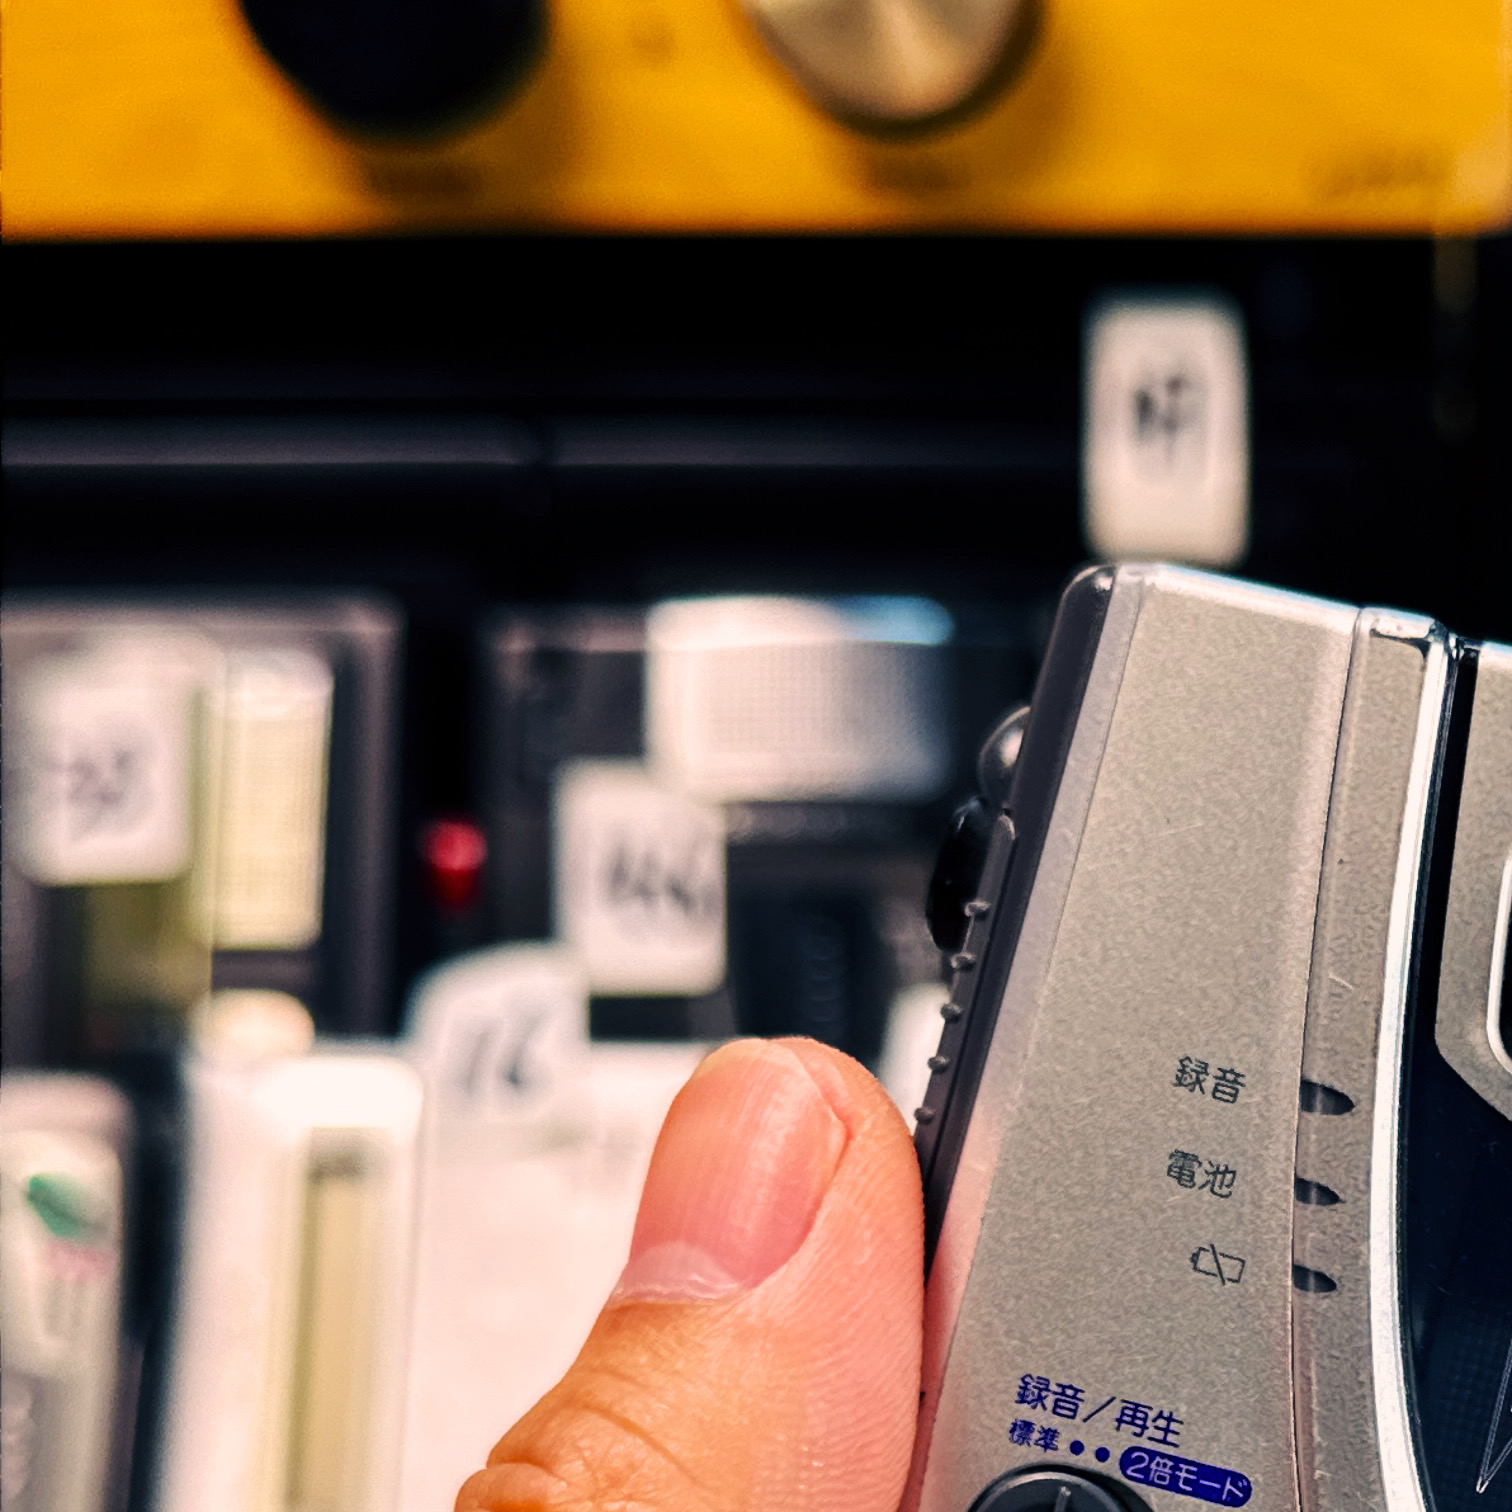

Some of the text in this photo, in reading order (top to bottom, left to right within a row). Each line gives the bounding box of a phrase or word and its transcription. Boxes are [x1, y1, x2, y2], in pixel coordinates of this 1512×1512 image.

[1171, 1056, 1247, 1104] 録音
[1166, 1149, 1237, 1199] 電池
[1008, 1418, 1247, 1501] 標準 2倍モード
